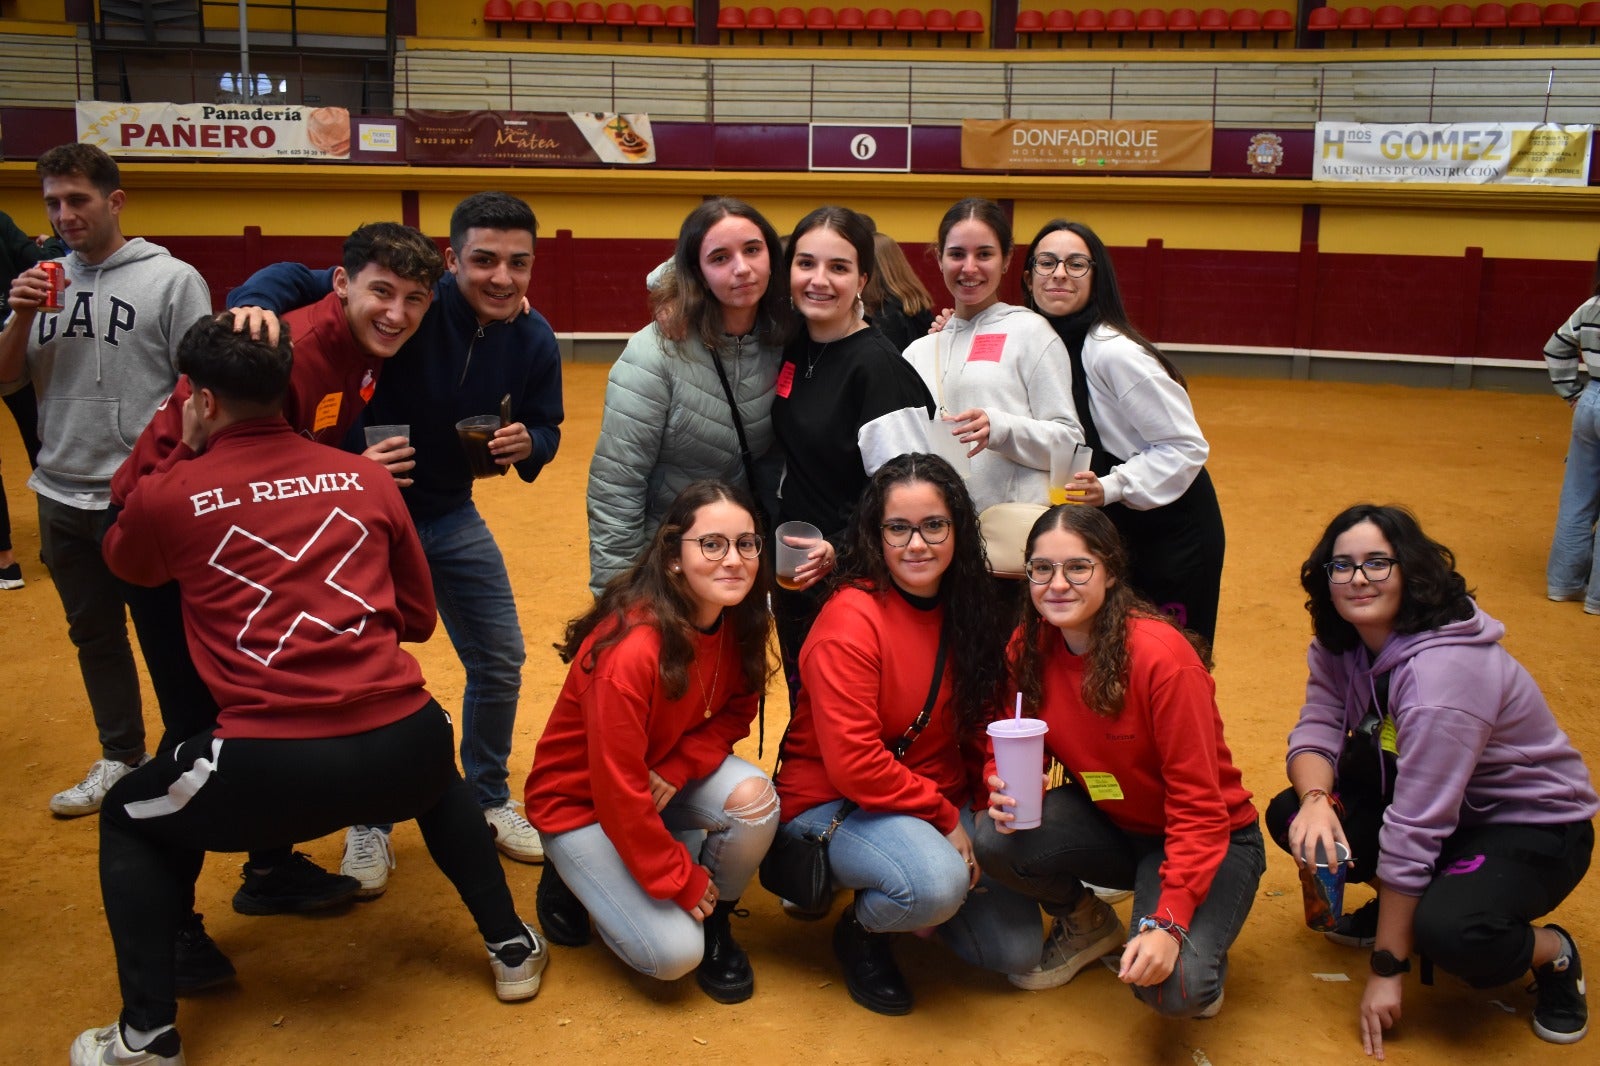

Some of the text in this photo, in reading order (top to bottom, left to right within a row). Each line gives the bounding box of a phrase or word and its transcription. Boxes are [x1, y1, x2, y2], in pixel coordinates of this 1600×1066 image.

[202, 106, 302, 121] Panadería
[120, 117, 276, 149] PAÑERO
[494, 129, 560, 150] Matea
[1012, 129, 1158, 147] DONFADRIQUE
[856, 136, 869, 158] 6
[1380, 130, 1503, 161] GOMEZ
[1322, 165, 1500, 177] MATERIALES DE CONSTRUCCIÓN
[38, 291, 137, 347] GAP
[190, 472, 364, 517] EL REMIX
